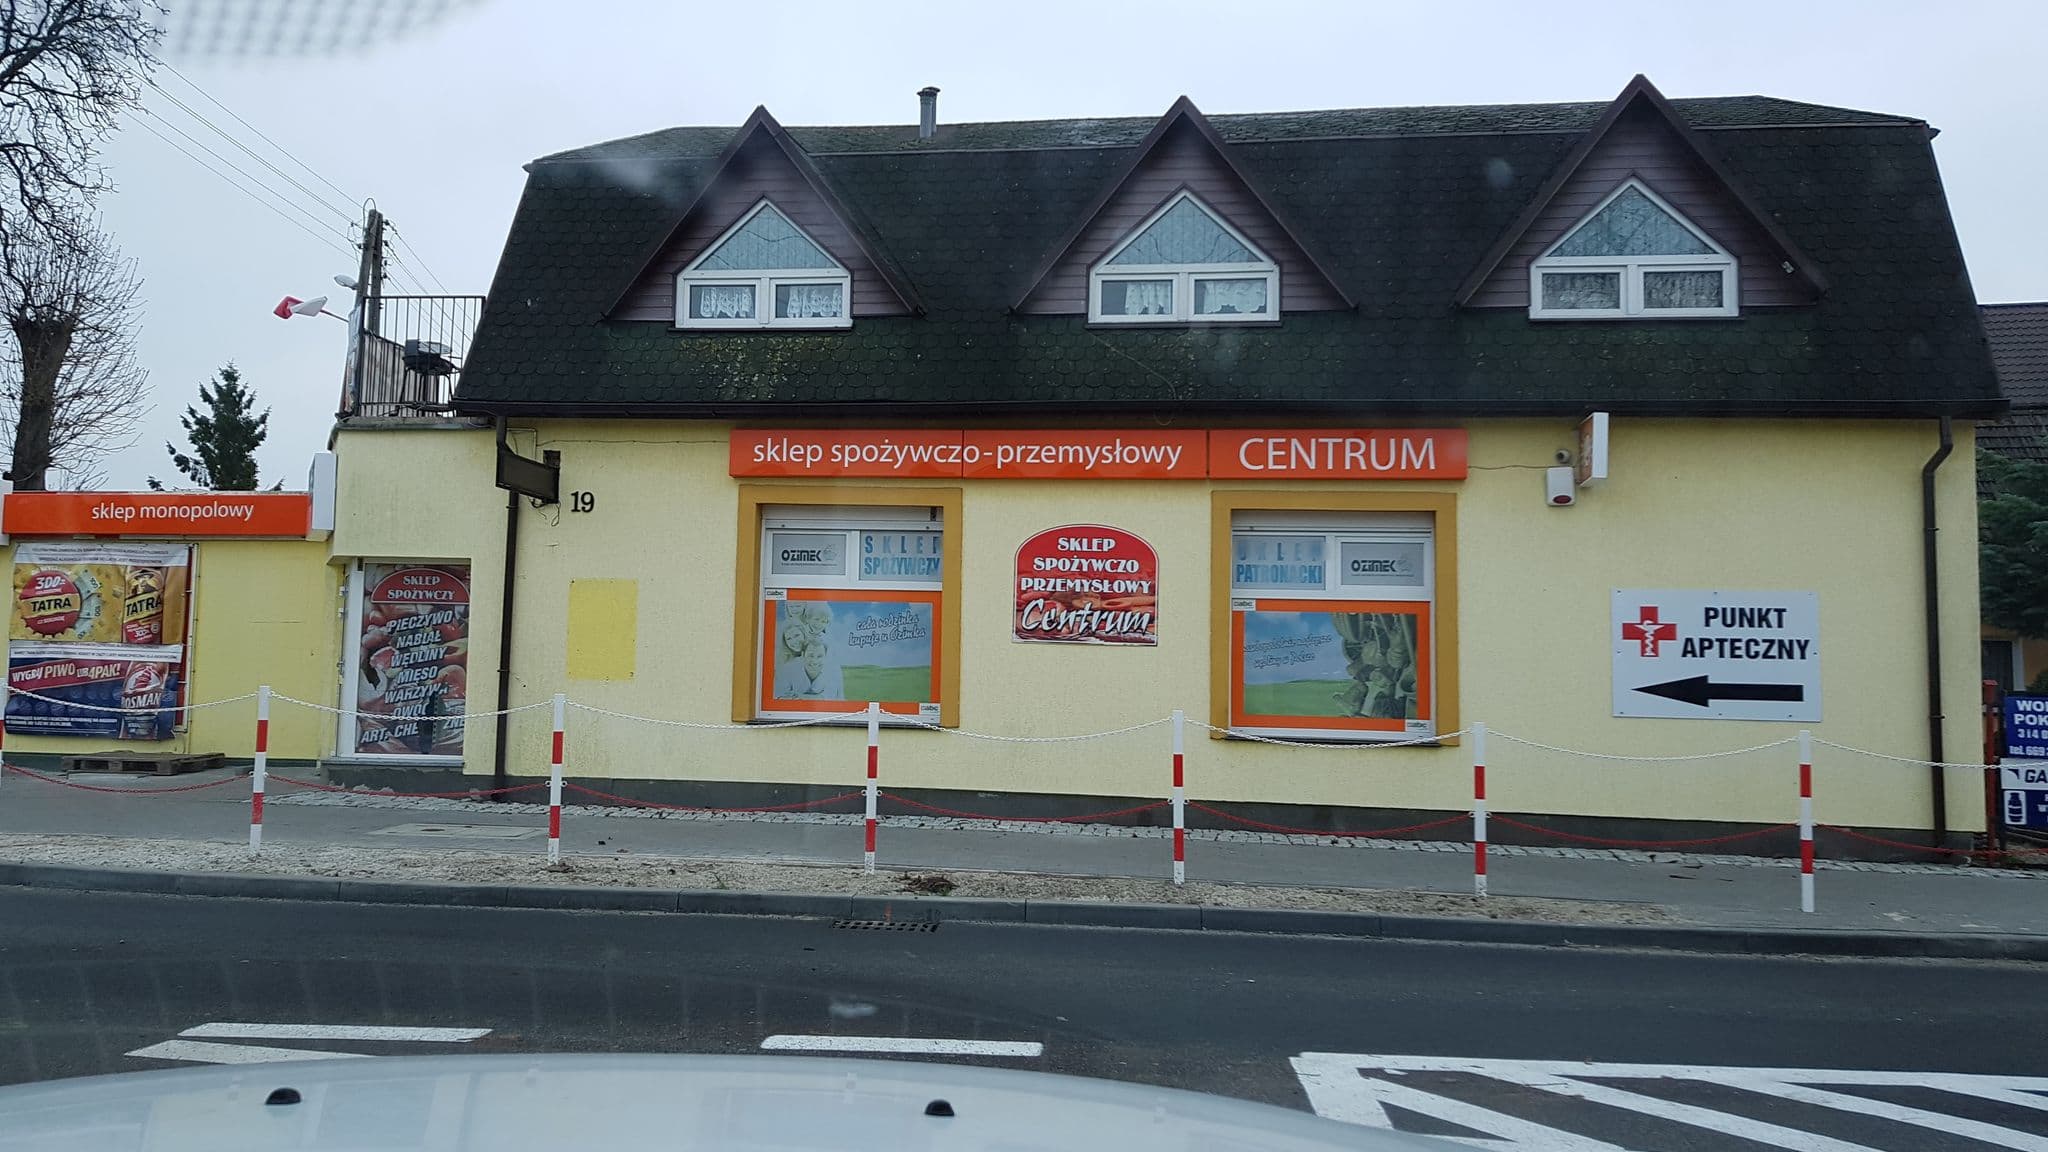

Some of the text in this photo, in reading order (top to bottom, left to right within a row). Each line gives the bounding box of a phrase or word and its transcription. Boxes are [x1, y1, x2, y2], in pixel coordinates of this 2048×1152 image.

[753, 438, 823, 469] sklep
[1239, 438, 1436, 470] CENTRUM
[92, 501, 254, 523] sklep monopolowy
[570, 491, 595, 513] 19
[1057, 537, 1116, 552] SKLEP
[1033, 555, 1140, 573] SPOŻYWCZO
[403, 575, 441, 586] SKLEP
[1020, 577, 1151, 594] PRZEMYSŁOWY
[30, 597, 72, 612] TATRA
[126, 594, 162, 616] TATRA
[387, 588, 455, 600] SPOŻYWCZY
[385, 609, 454, 633] PIECZYWO
[1021, 598, 1150, 634] Centrum
[1704, 606, 1787, 629] PUNKT
[396, 631, 442, 649] NABIAŁ
[1681, 637, 1810, 660] APTECZNY
[391, 646, 448, 668] WĘDLINY
[44, 663, 76, 679] PIWO
